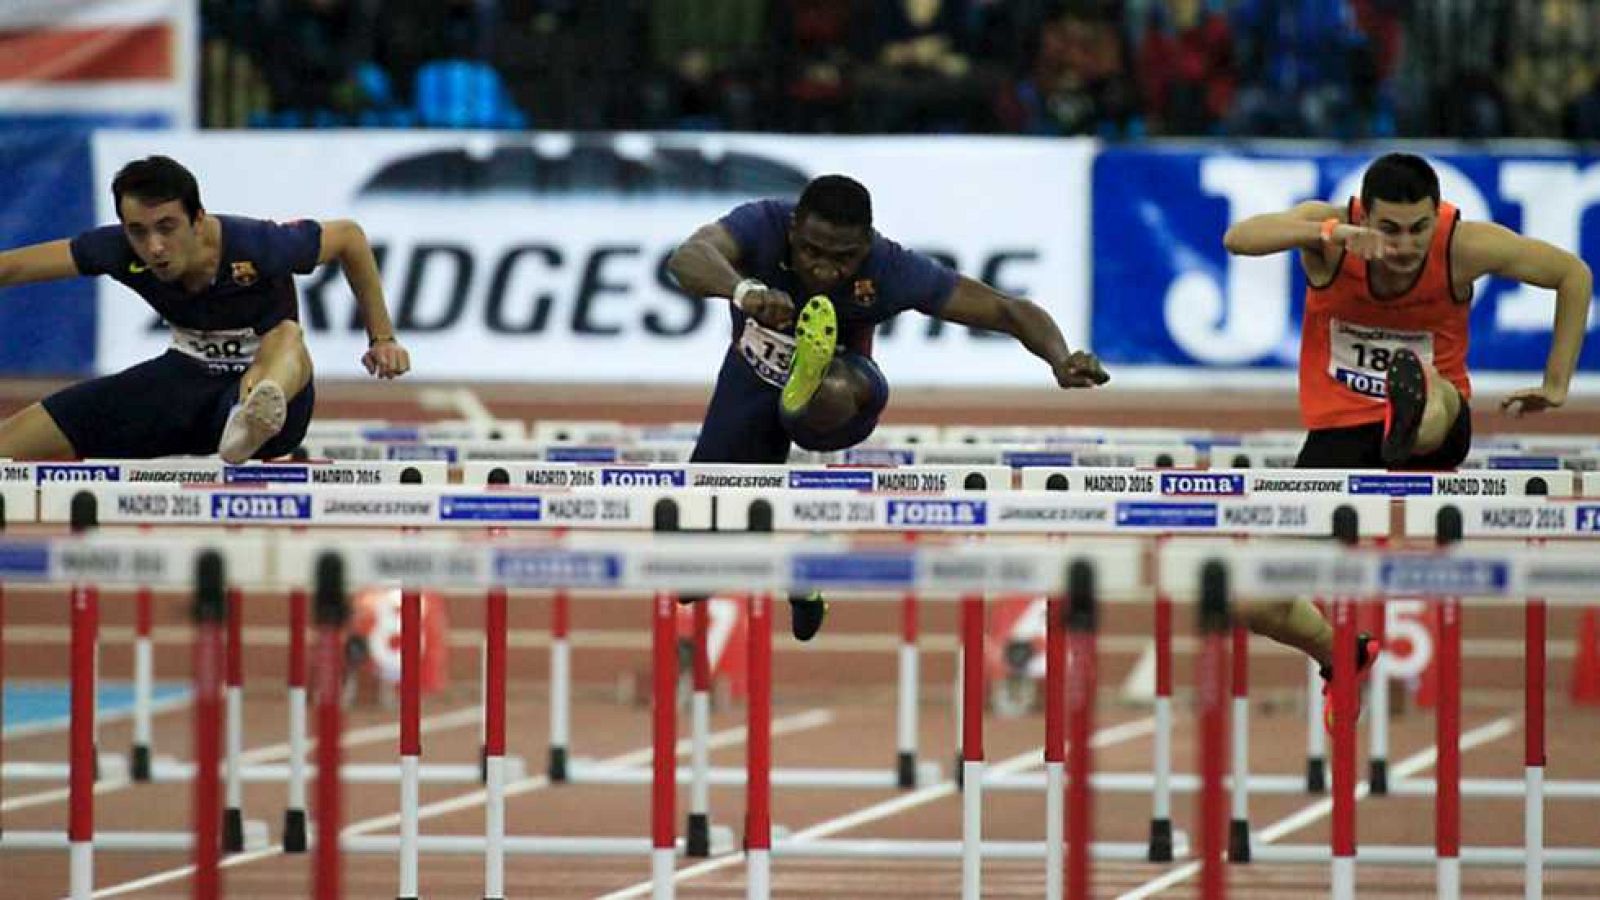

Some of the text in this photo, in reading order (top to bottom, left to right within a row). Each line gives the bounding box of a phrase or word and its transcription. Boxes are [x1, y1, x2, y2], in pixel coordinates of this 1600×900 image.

[312, 469, 354, 483] MADRID
[357, 469, 381, 483] 2016
[525, 470, 567, 485] MADRID
[570, 470, 595, 485] 2016
[694, 474, 784, 487] BRIDGESTONE
[877, 474, 918, 490] MADRID
[919, 474, 946, 491] 2016
[1084, 475, 1126, 492] MADRID
[1127, 475, 1153, 492] 2016
[1253, 479, 1344, 492] BRIDGESTONE
[1437, 478, 1479, 495] MADRID
[1481, 478, 1507, 495] 2016
[117, 494, 167, 516] MADRID
[170, 495, 200, 516] 2016
[548, 499, 597, 519] MADRID
[793, 502, 842, 522] MADRID
[1223, 504, 1273, 525] MADRID
[1482, 508, 1533, 528] MADRID
[1535, 508, 1565, 529] 2016
[1378, 600, 1432, 677] 5
